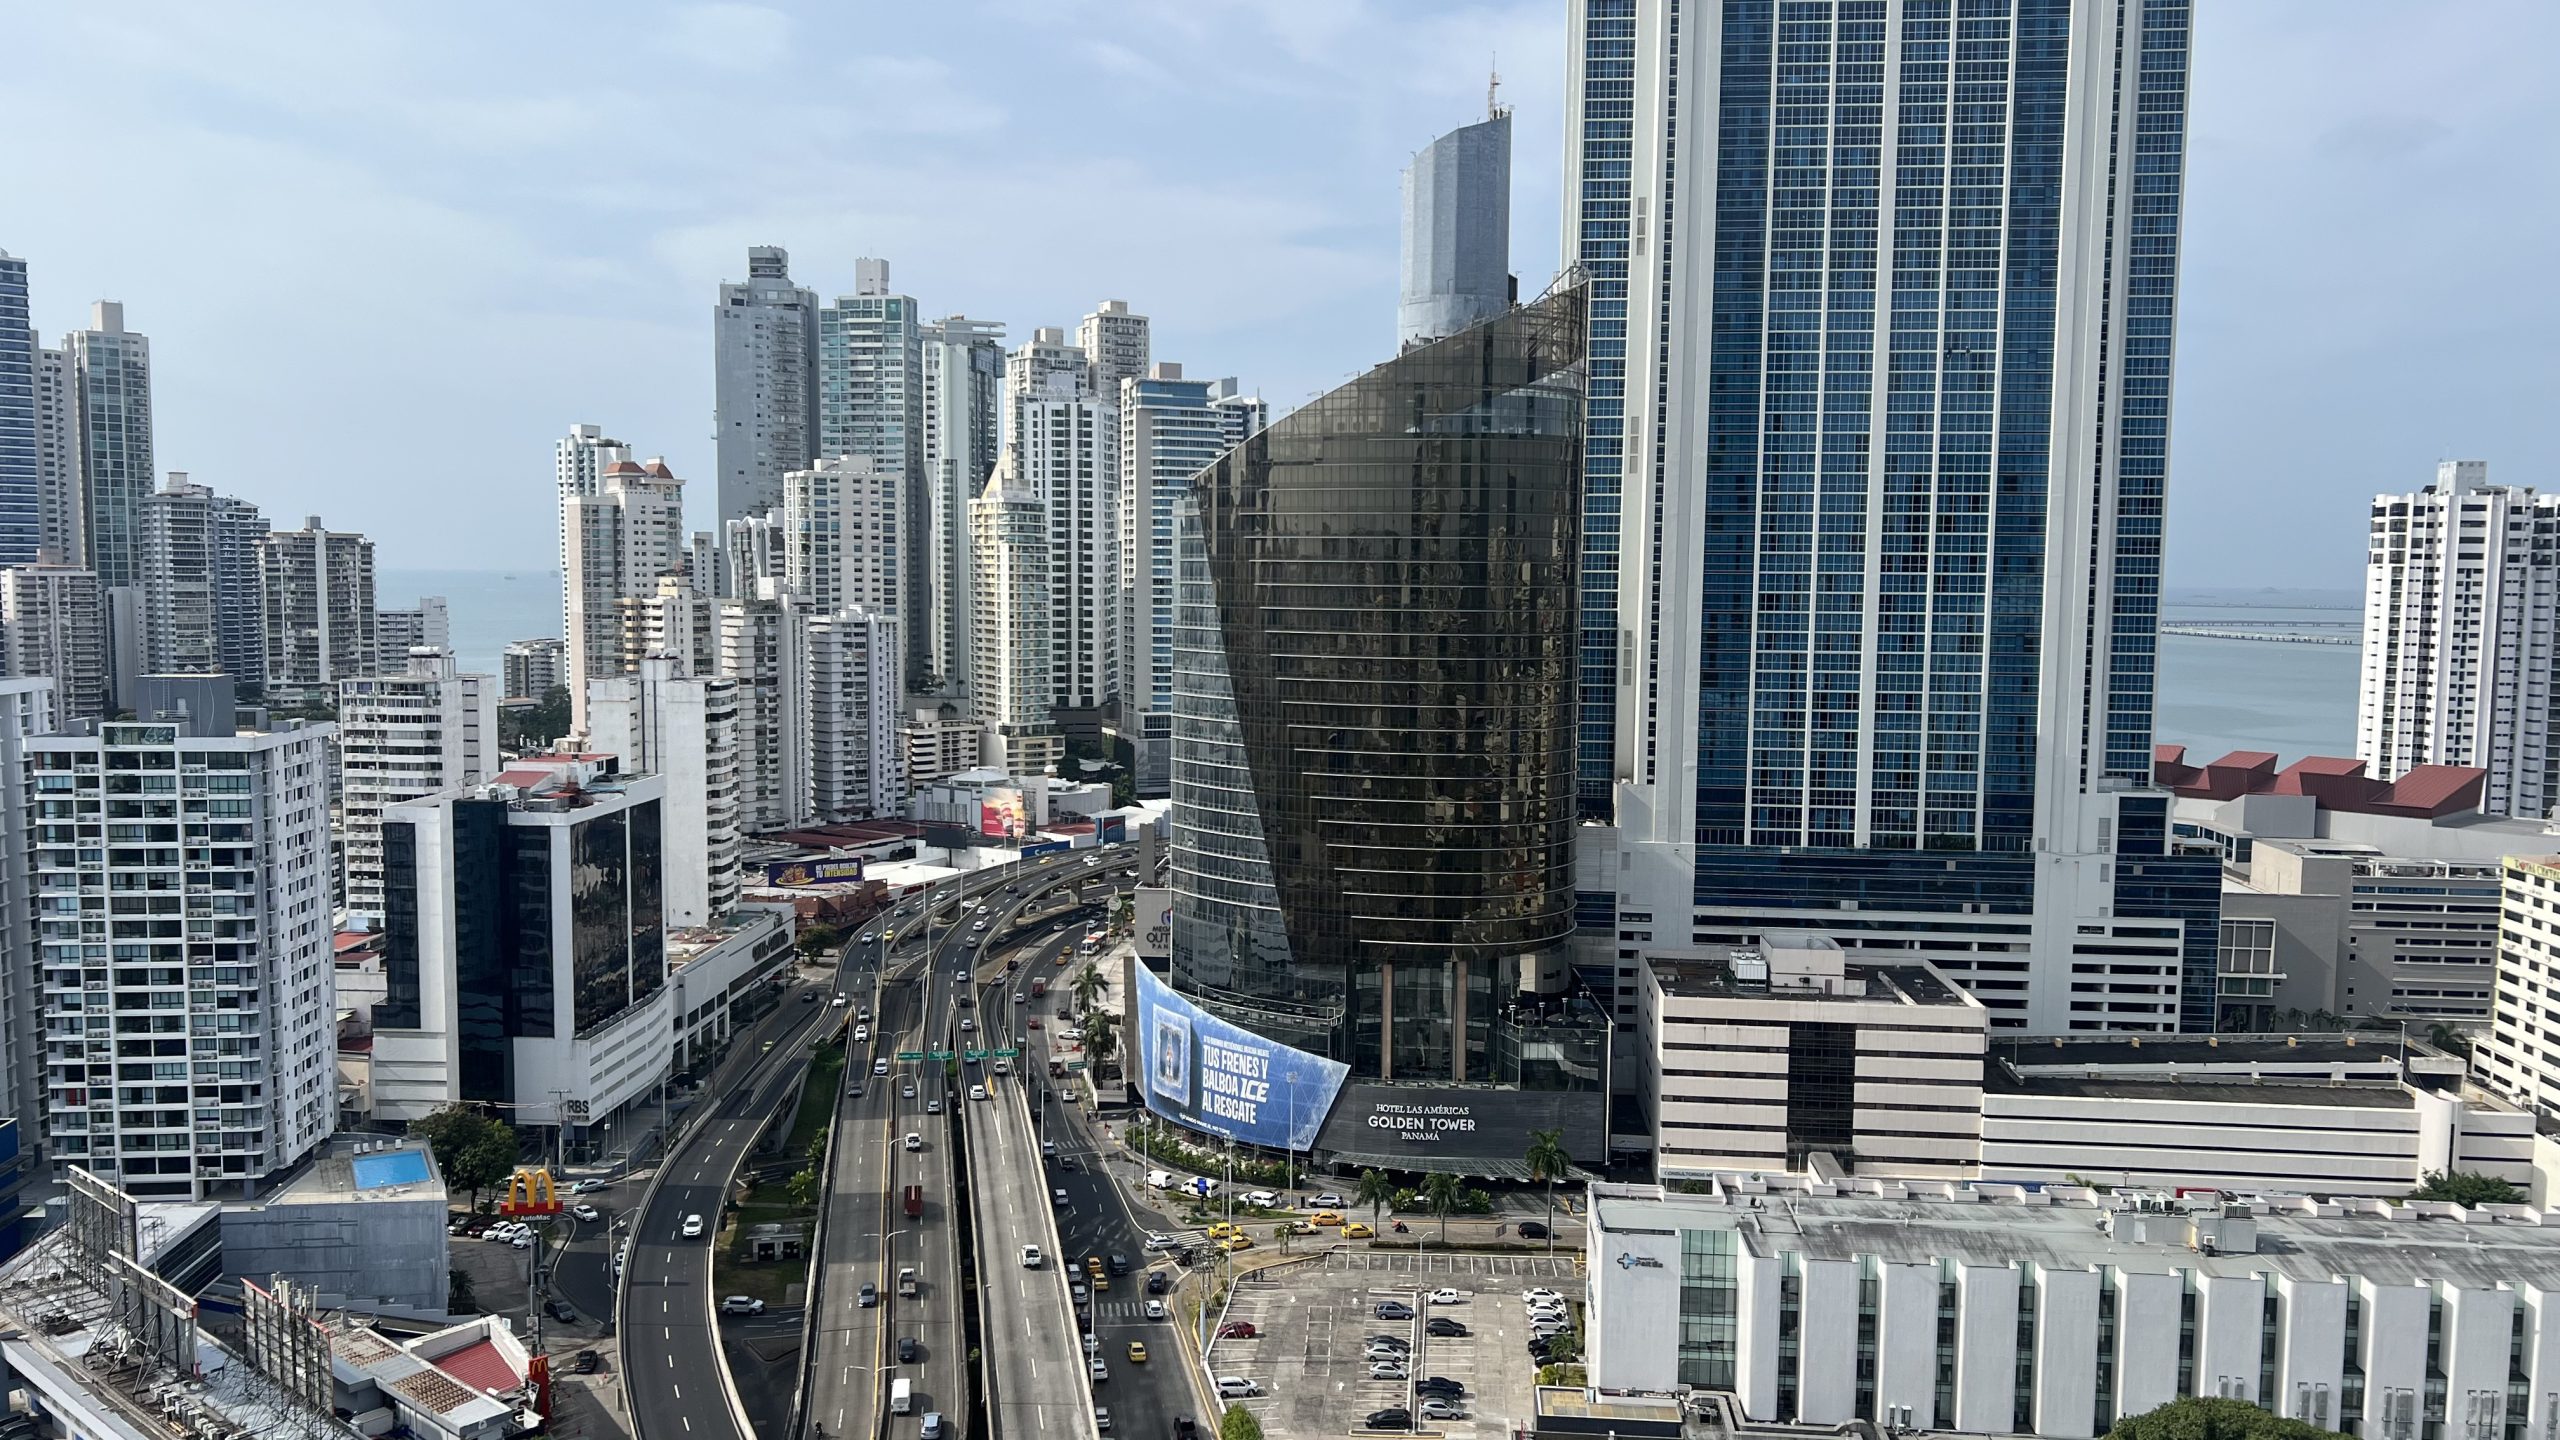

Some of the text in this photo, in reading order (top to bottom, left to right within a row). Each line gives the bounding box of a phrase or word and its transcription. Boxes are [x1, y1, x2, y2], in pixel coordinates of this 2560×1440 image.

[1203, 1044, 1220, 1068] TUS
[1221, 1049, 1260, 1078] FRENES
[1261, 1058, 1268, 1080] Y
[1202, 1067, 1270, 1103] BALBOA ICE
[567, 1099, 589, 1113] RBS
[1202, 1090, 1213, 1113] AL
[1214, 1093, 1257, 1125] RESCATE
[1376, 1104, 1470, 1115] HOTEL LAS AMÉRICAS
[1368, 1115, 1475, 1131] GOLDEN TOWER
[1401, 1131, 1440, 1141] PANAMÁ
[520, 1214, 551, 1222] AutoMac
